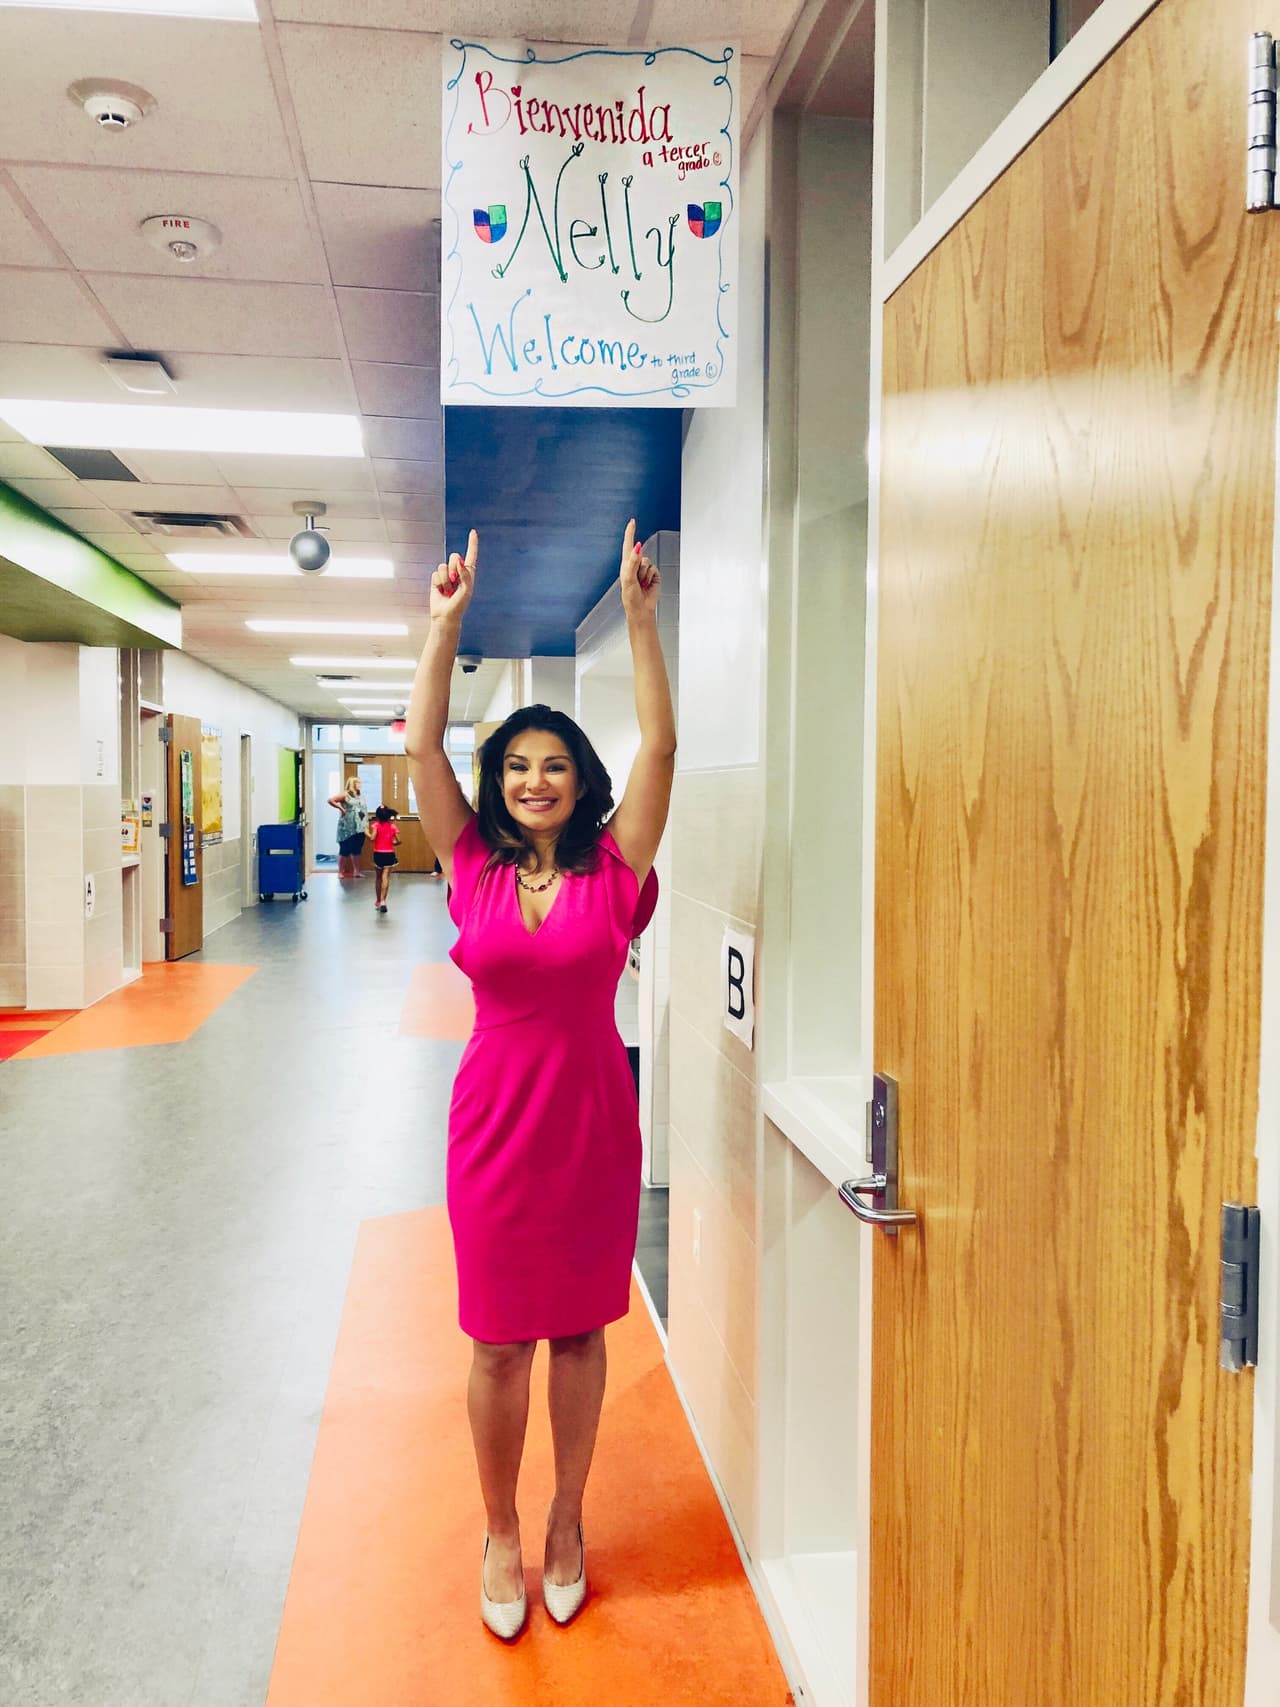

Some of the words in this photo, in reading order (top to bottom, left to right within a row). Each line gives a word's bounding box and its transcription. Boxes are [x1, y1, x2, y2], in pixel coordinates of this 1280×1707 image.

[467, 71, 673, 144] Bienvenida
[642, 151, 654, 168] a
[658, 141, 711, 163] tercer
[678, 155, 710, 181] grado
[162, 219, 190, 229] FIRE
[491, 143, 680, 323] Nelly
[466, 288, 648, 375] Welcome
[650, 354, 663, 369] to
[667, 352, 696, 366] third
[672, 367, 701, 385] grade
[728, 946, 745, 1020] B
